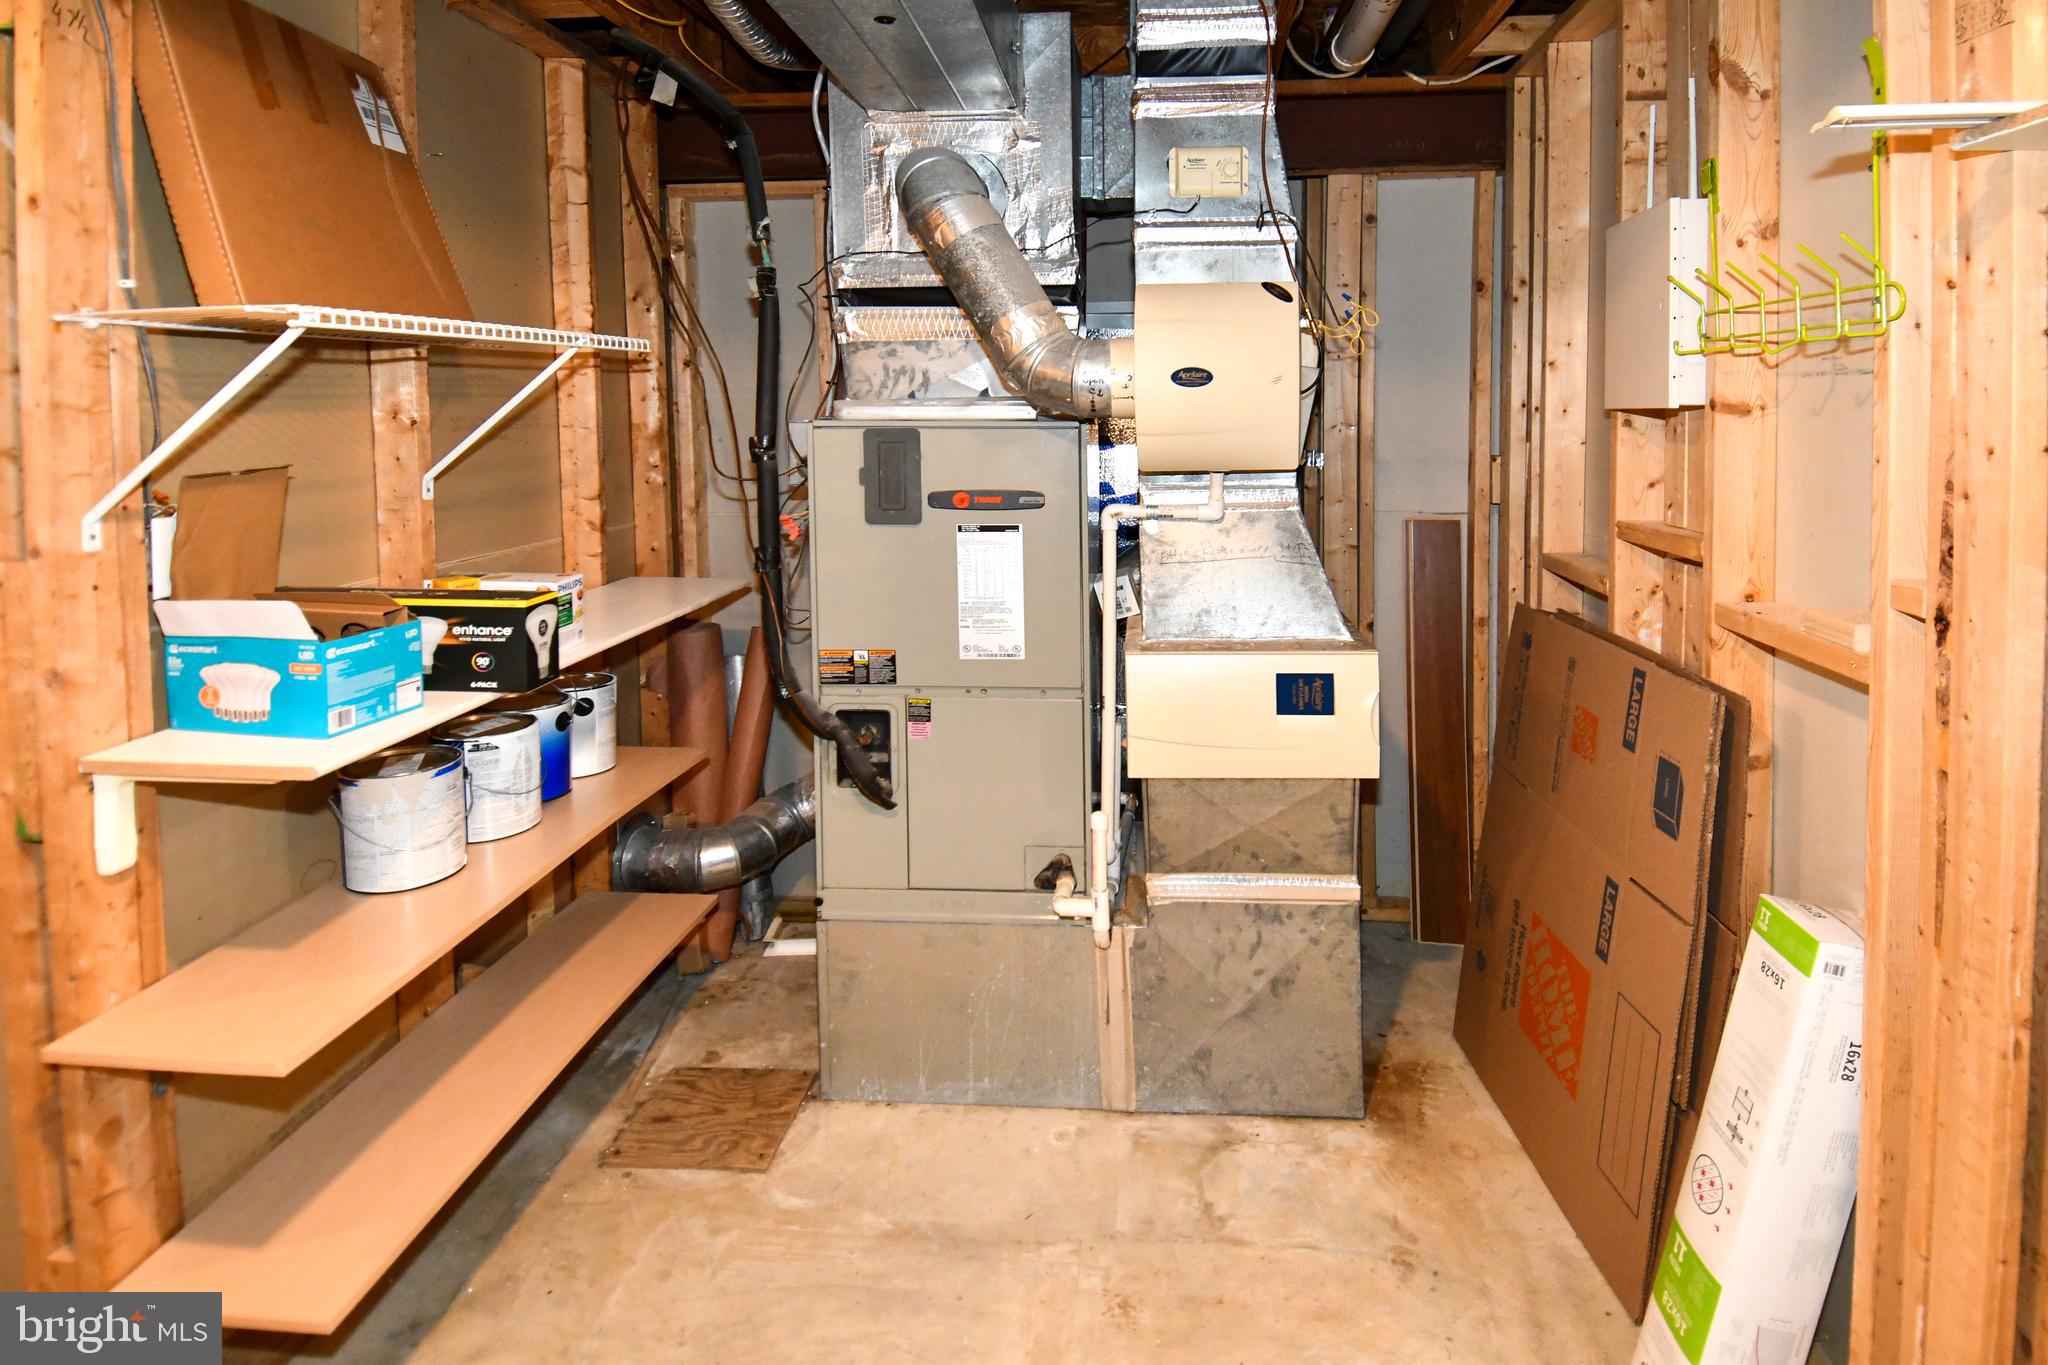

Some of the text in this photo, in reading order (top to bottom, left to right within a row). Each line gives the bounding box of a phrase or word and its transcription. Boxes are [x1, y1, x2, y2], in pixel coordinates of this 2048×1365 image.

[1178, 370, 1208, 379] Aprilaire
[558, 578, 582, 592] PHILIPS
[452, 625, 512, 636] enhance
[178, 646, 217, 654] ecosmart
[335, 639, 377, 656] ecosmart
[1625, 678, 1643, 743] LARGE
[1599, 886, 1617, 959] LARGE
[1761, 961, 1785, 990] 16x28
[1841, 1041, 1862, 1082] 16x28
